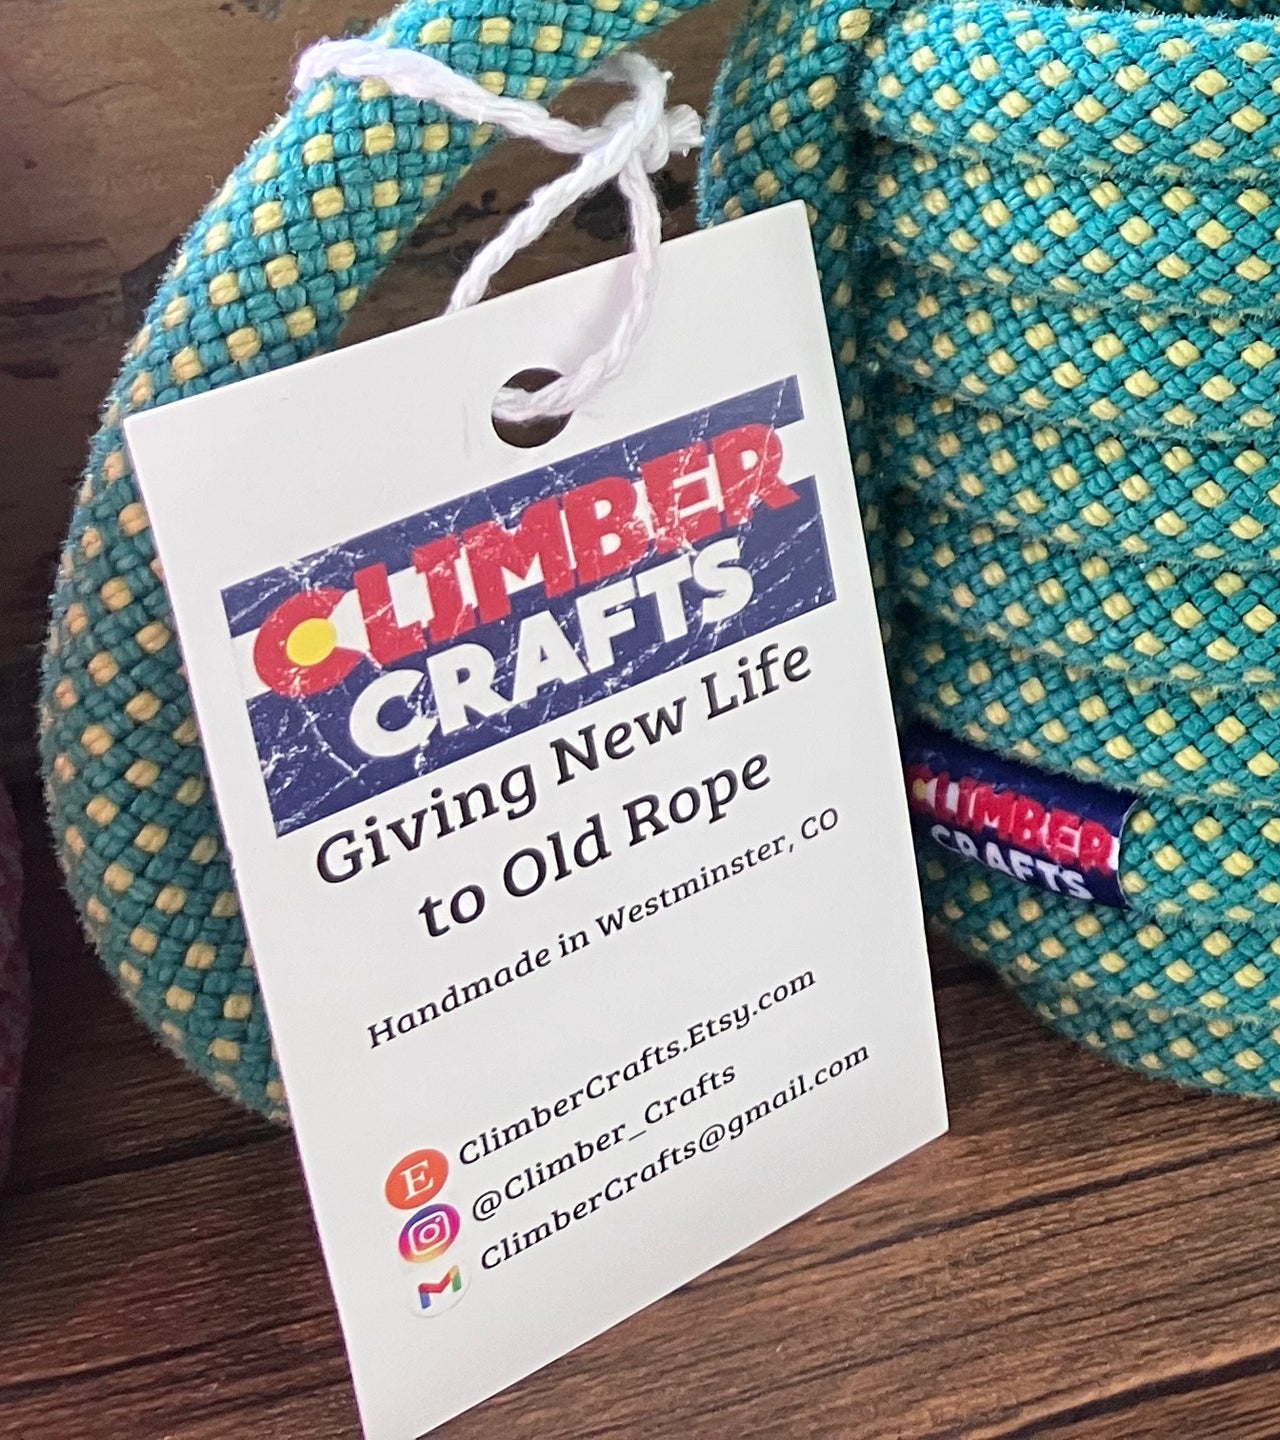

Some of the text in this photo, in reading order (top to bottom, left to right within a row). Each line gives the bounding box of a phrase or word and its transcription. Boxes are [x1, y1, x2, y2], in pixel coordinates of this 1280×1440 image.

[253, 422, 802, 700] CLIMBER
[348, 536, 754, 761] CRAFTS
[314, 640, 812, 885] Giving New Life
[418, 751, 771, 938] to Old Rope
[906, 765, 1113, 876] CLIMBER
[931, 824, 1094, 900] CRAFTS
[367, 807, 840, 1049] Handmade in Westminster, CO
[458, 969, 817, 1166] ClimberCrafts.Etsy.com
[472, 1064, 737, 1223] @Climber_Crafts
[480, 1044, 870, 1271] ClimberCrafts@gmail.com
